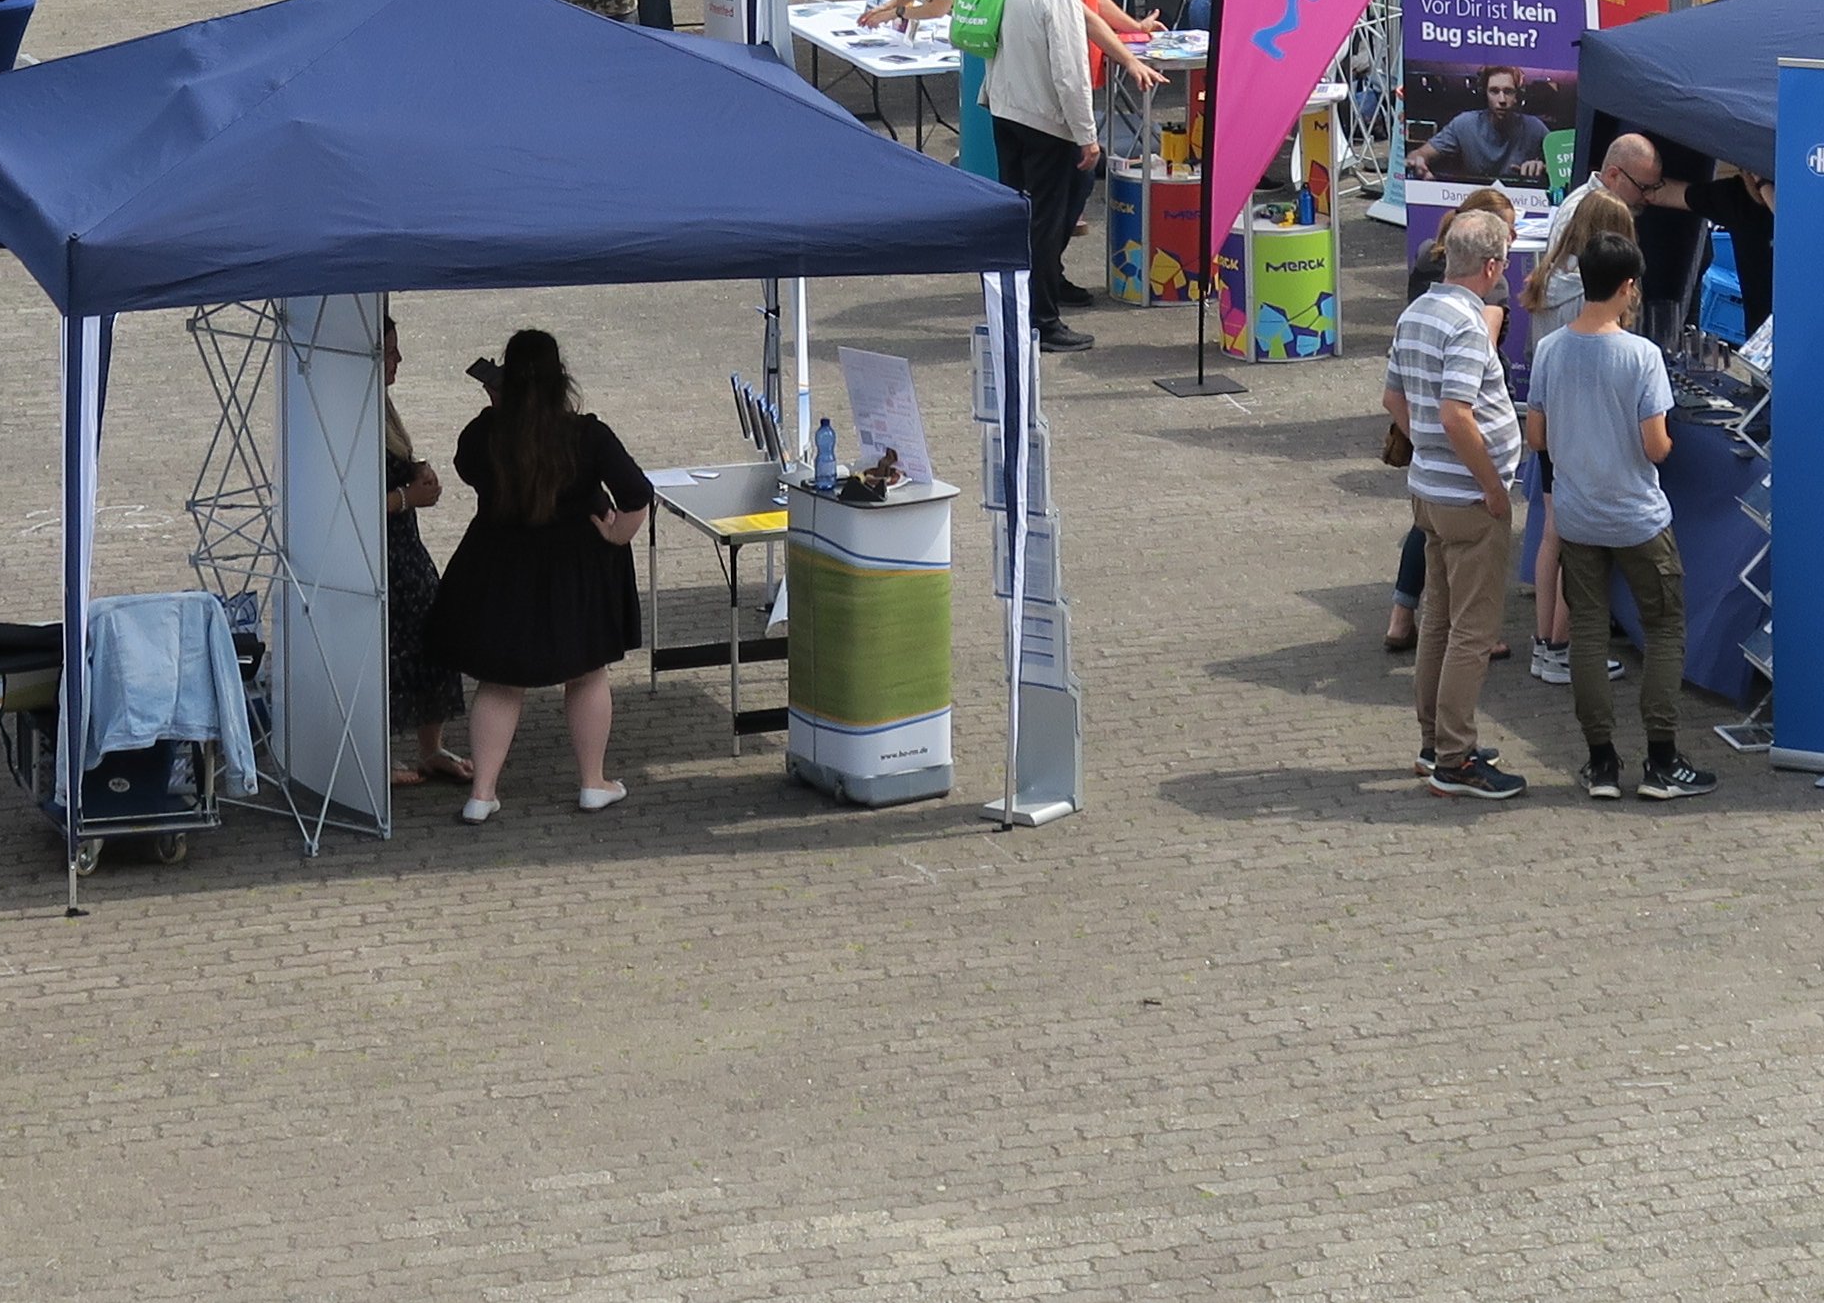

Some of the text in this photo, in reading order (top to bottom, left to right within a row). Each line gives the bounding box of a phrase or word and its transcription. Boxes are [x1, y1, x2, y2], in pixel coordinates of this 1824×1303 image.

[1487, 0, 1507, 20] ist
[1513, 0, 1557, 23] kein
[1422, 21, 1538, 48] Bug sicher?
[1265, 258, 1325, 273] MERCK
